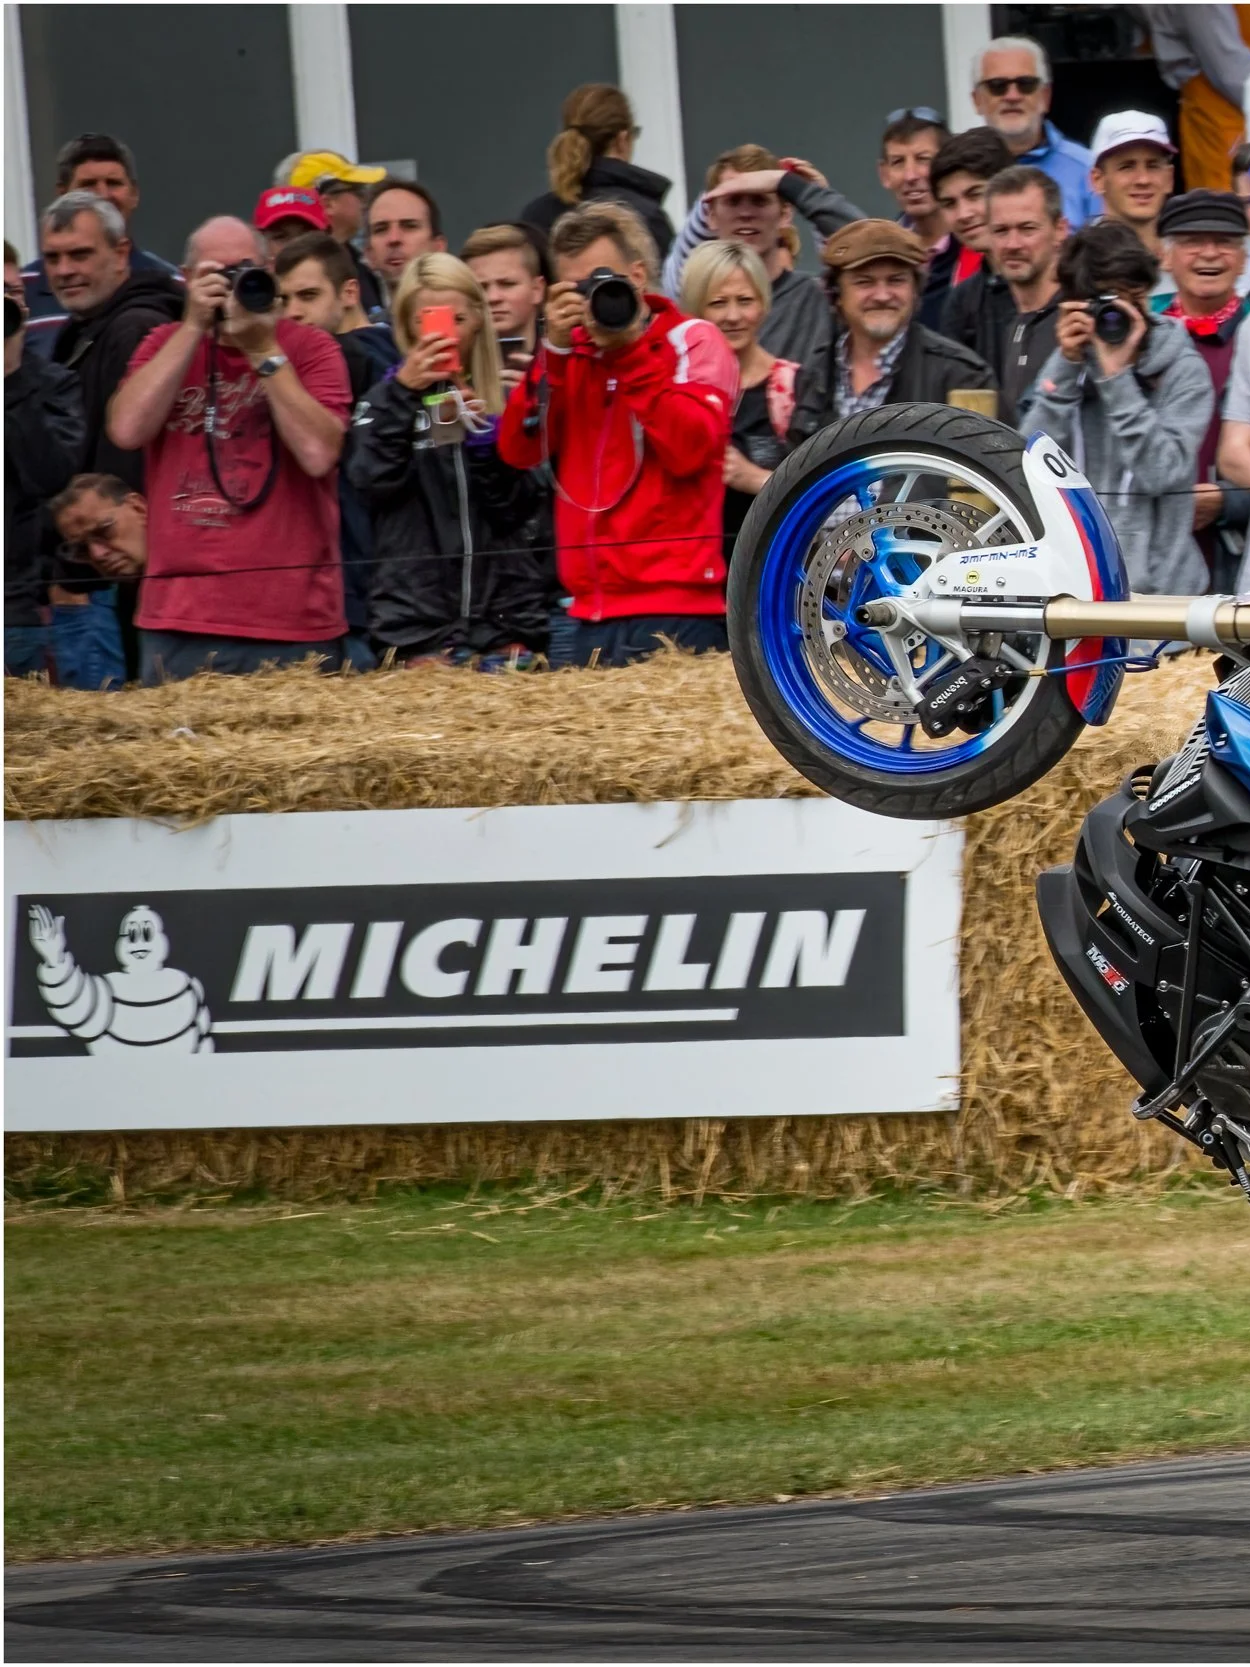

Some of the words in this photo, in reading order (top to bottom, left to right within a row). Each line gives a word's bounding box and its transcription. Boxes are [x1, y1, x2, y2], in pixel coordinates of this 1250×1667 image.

[959, 546, 1038, 564] METZELER
[930, 675, 969, 709] brembo
[1113, 901, 1155, 945] TOURATECH
[229, 908, 868, 1001] MICHELIN
